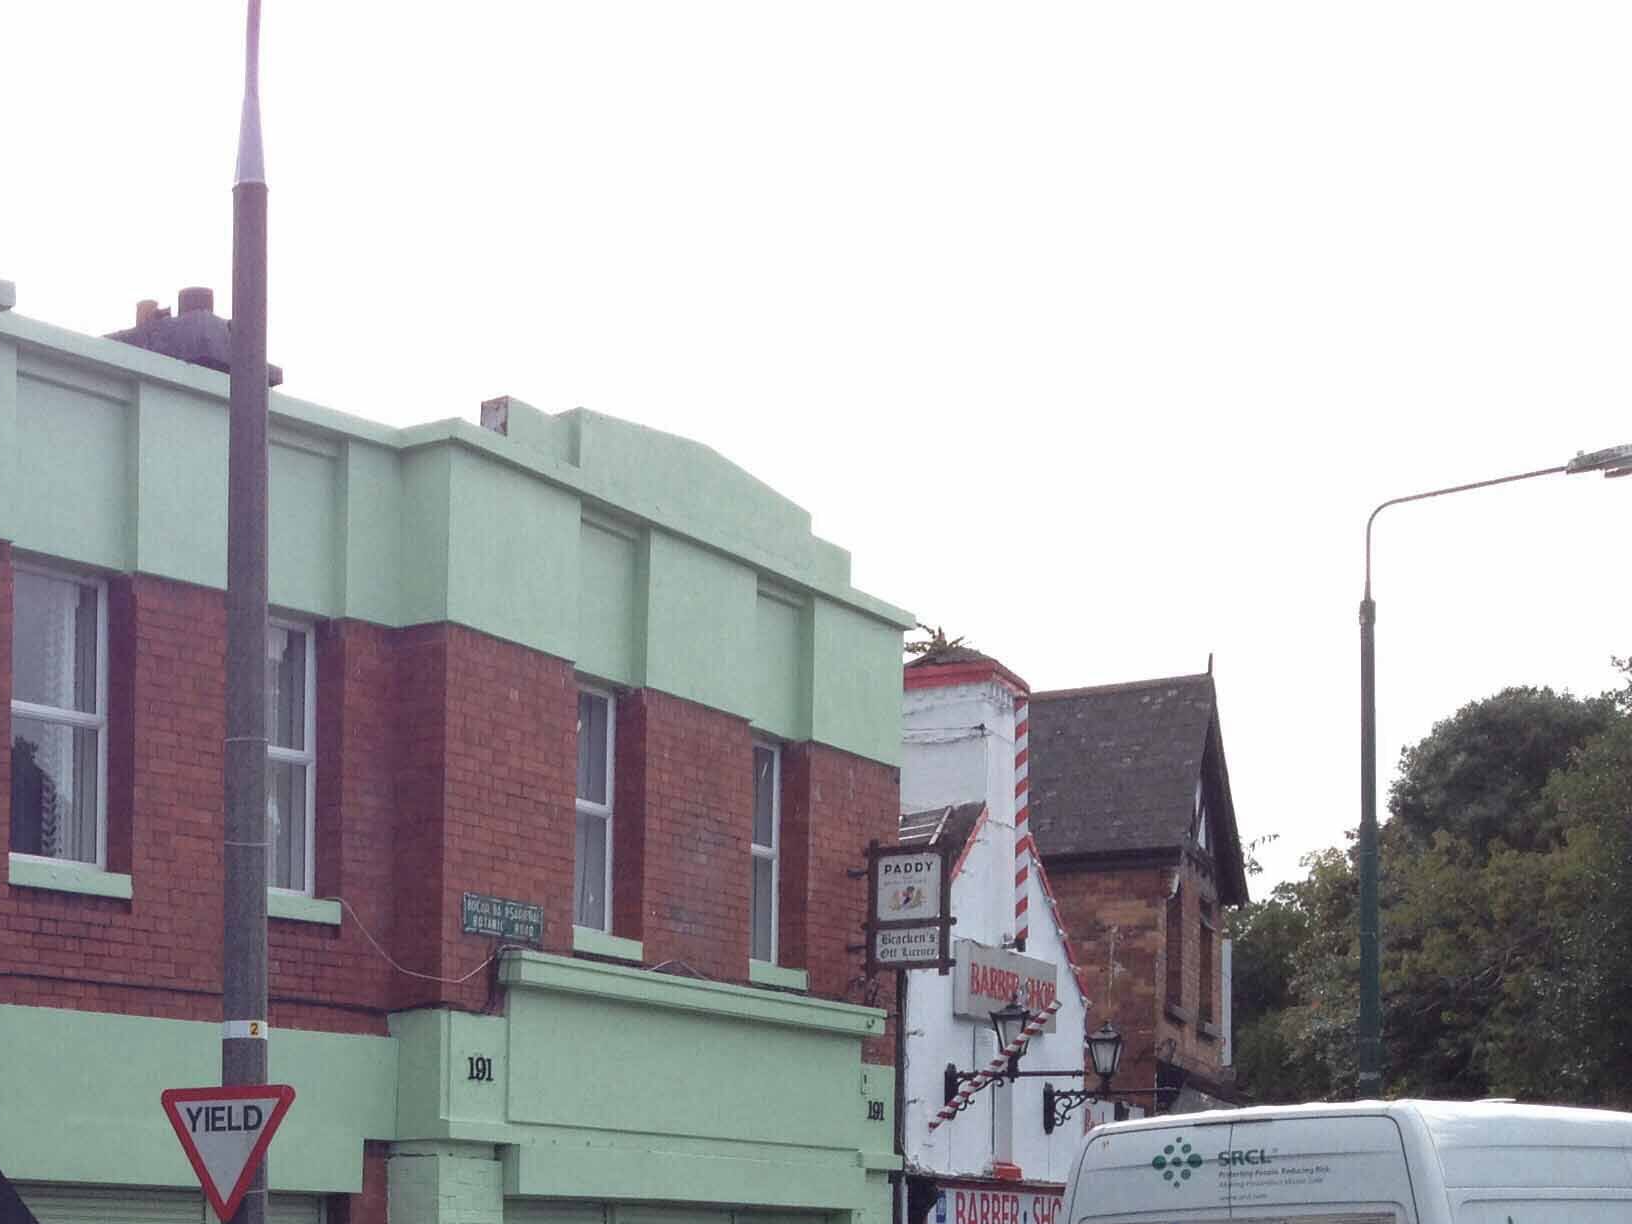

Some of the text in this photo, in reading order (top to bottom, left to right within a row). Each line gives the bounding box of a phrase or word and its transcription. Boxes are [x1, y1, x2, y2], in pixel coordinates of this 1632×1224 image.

[884, 861, 933, 875] PADDY
[971, 960, 1020, 1003] BARBER
[467, 1056, 494, 1082] 191
[185, 1104, 263, 1133] YIELD
[867, 1100, 886, 1121] 191
